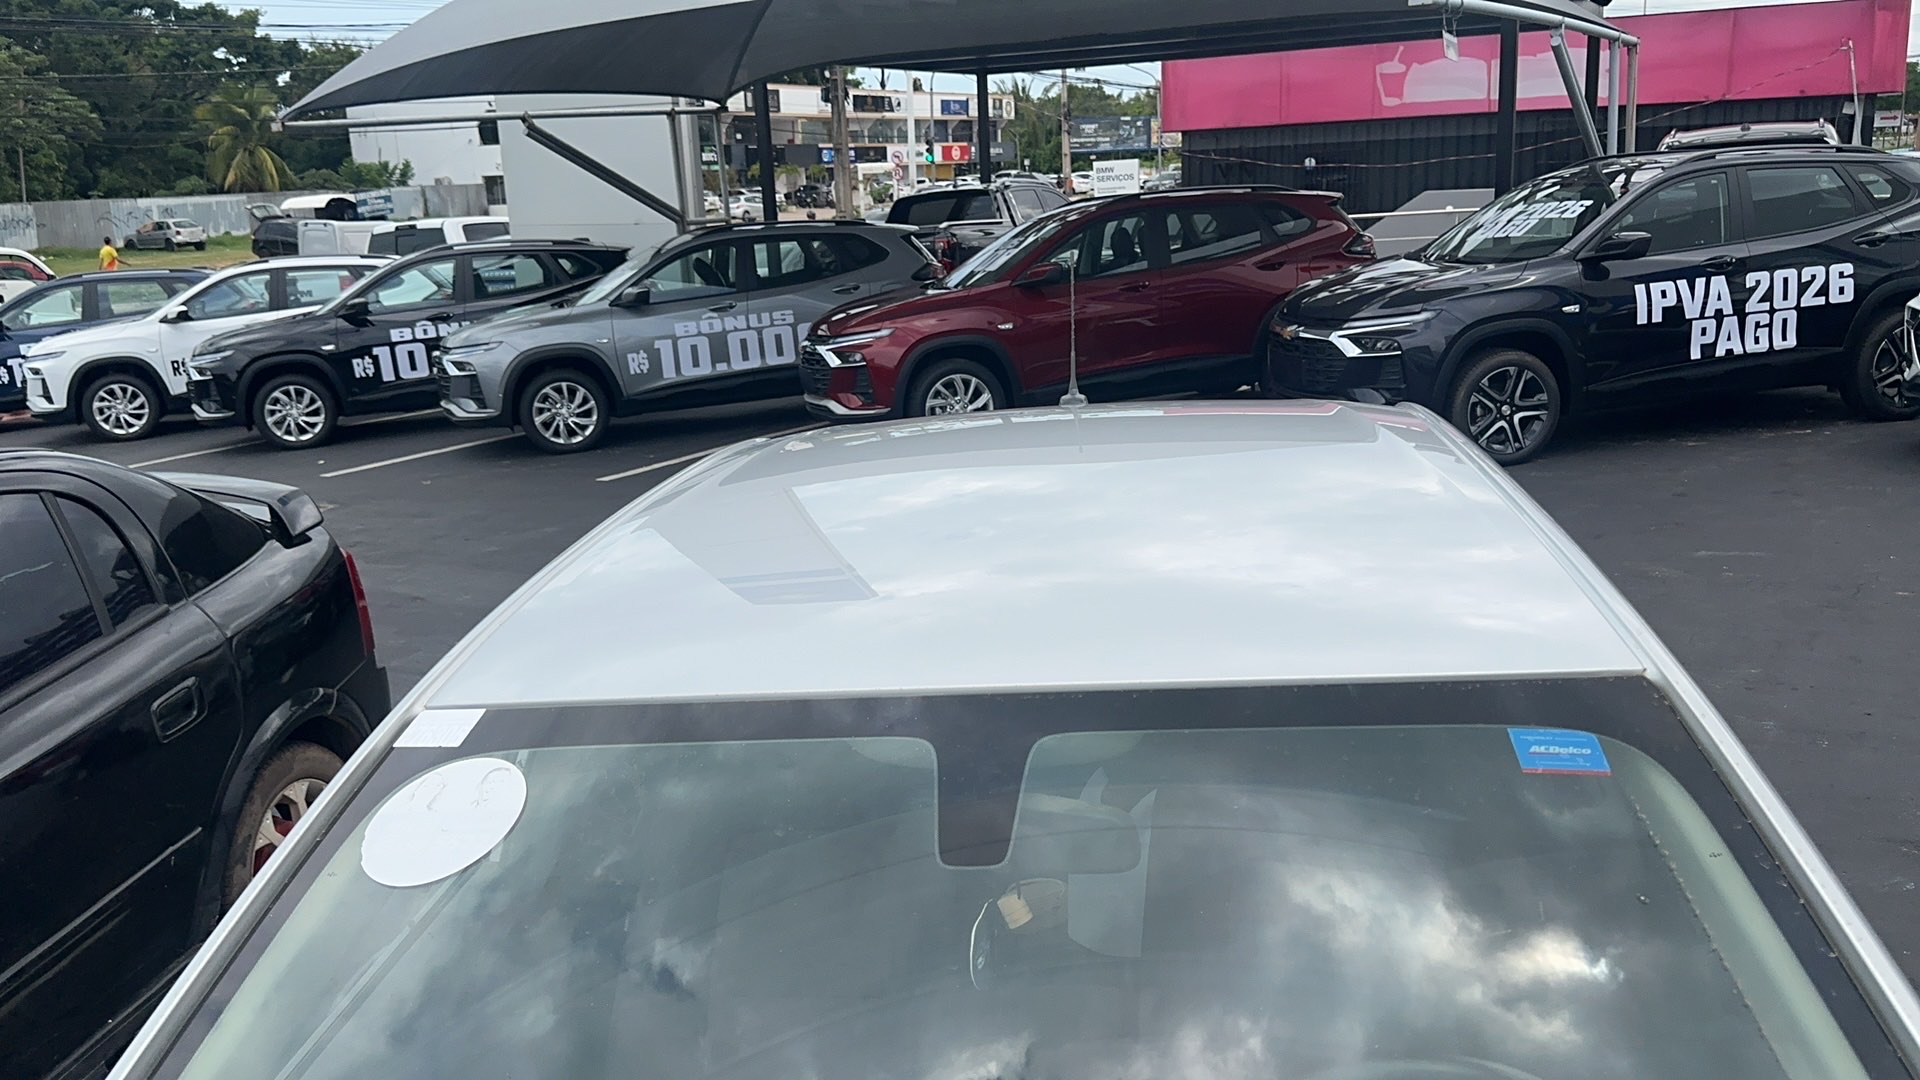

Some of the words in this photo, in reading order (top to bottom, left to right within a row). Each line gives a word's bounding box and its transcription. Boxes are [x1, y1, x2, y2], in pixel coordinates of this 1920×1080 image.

[1634, 275, 1734, 325] IPVA
[1745, 263, 1855, 313] 2026
[674, 310, 794, 337] BÔNUS
[1690, 309, 1797, 360] PAGO
[352, 355, 375, 378] R$
[627, 350, 649, 375] R$
[1529, 745, 1592, 755] ACDelco
